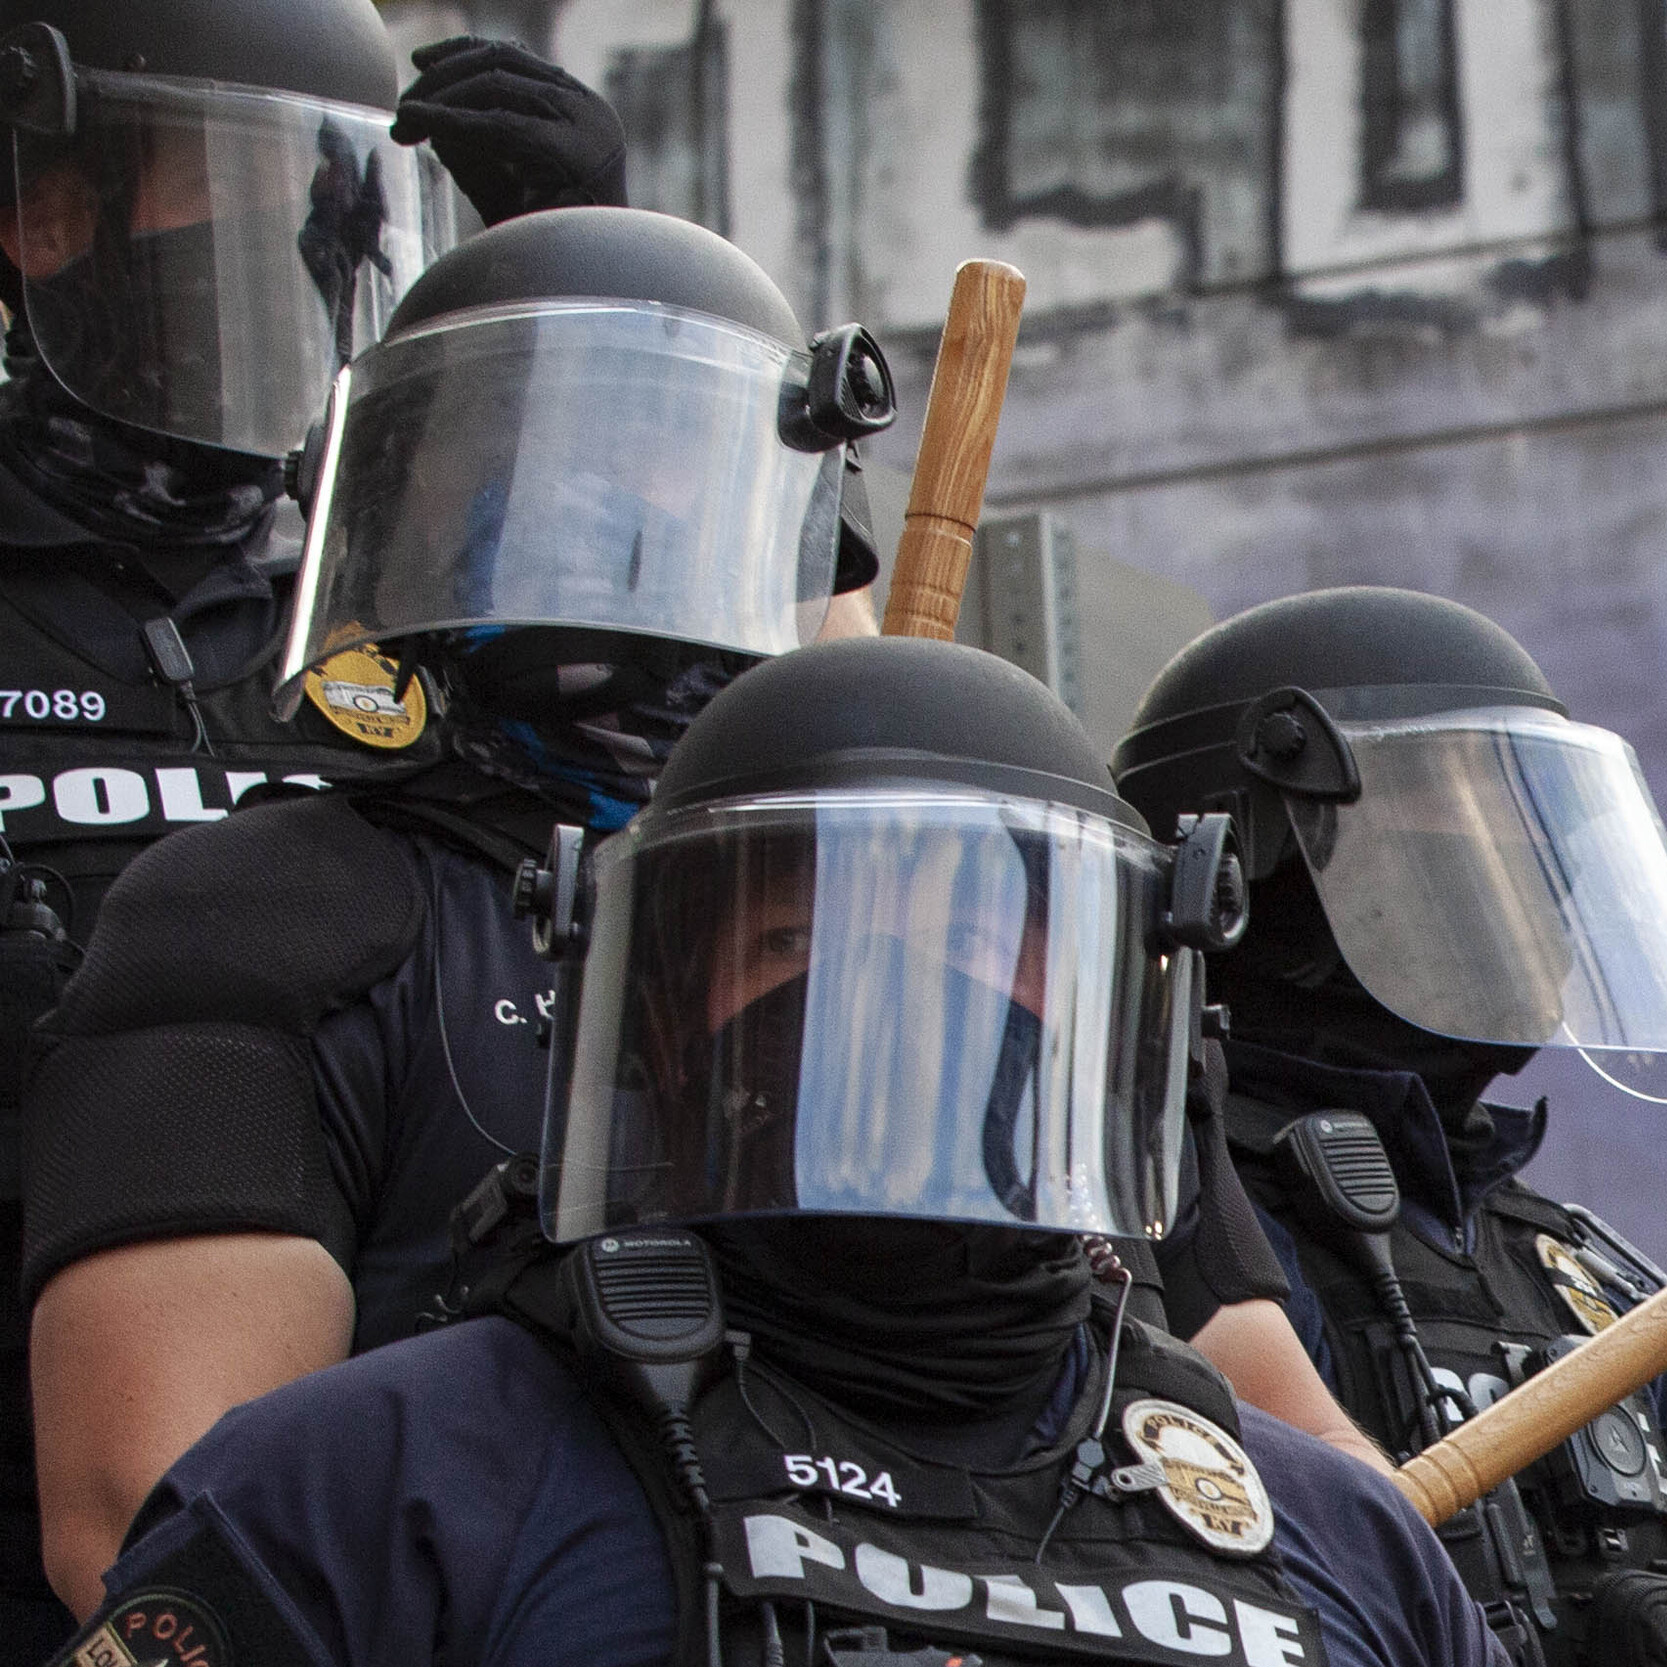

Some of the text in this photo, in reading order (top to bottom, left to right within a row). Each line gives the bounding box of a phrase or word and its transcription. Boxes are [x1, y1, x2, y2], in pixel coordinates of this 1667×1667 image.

[0, 690, 107, 721] 7089
[0, 767, 334, 832] POL
[623, 1238, 693, 1249] MOTOROLA
[784, 1455, 902, 1508] 5124
